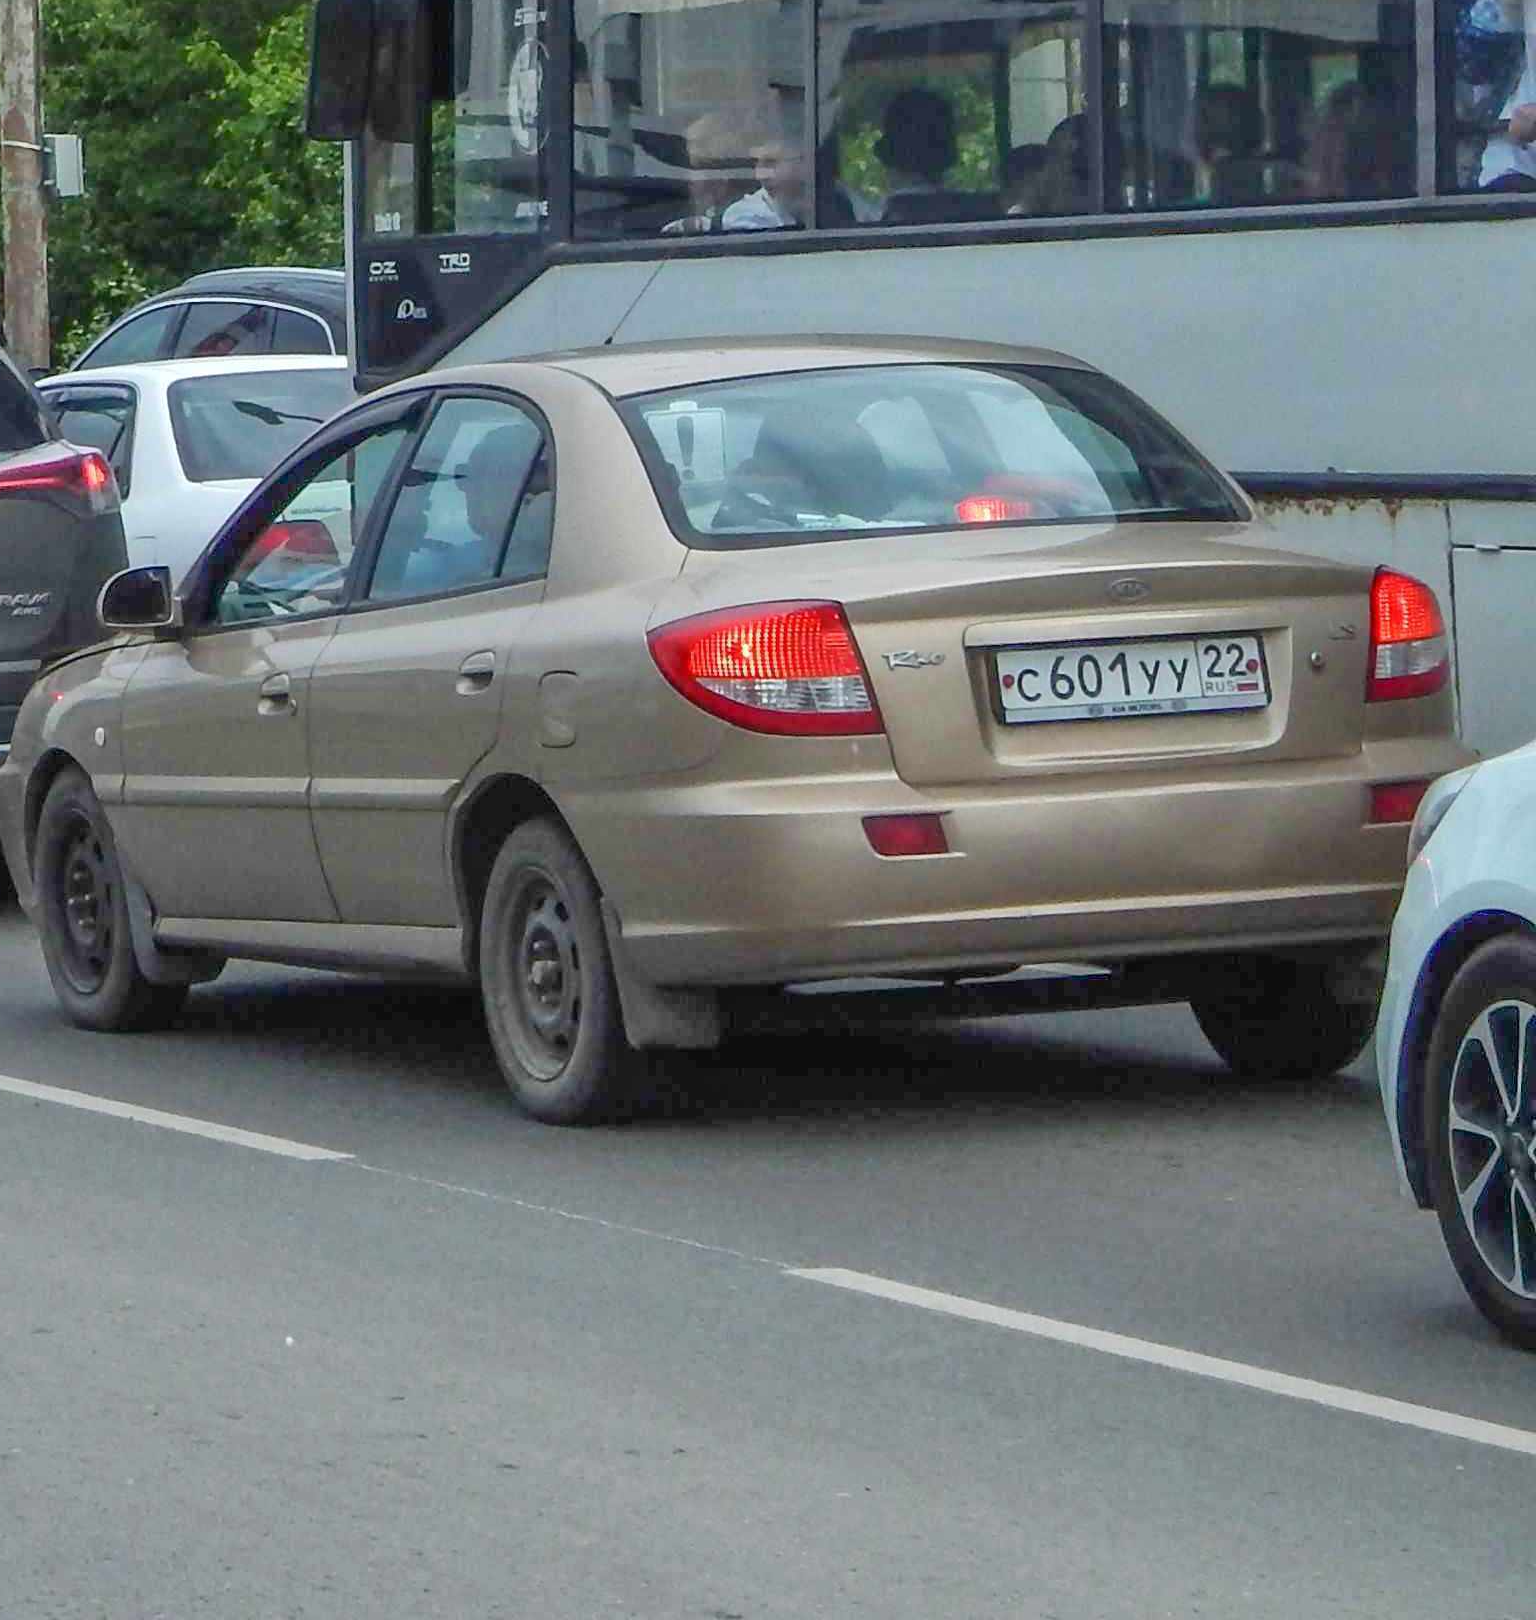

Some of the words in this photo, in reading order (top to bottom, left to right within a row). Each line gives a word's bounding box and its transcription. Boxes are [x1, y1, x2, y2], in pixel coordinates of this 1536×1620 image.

[439, 252, 471, 268] TRD
[1203, 643, 1248, 679] 22
[1205, 680, 1236, 692] RUS
